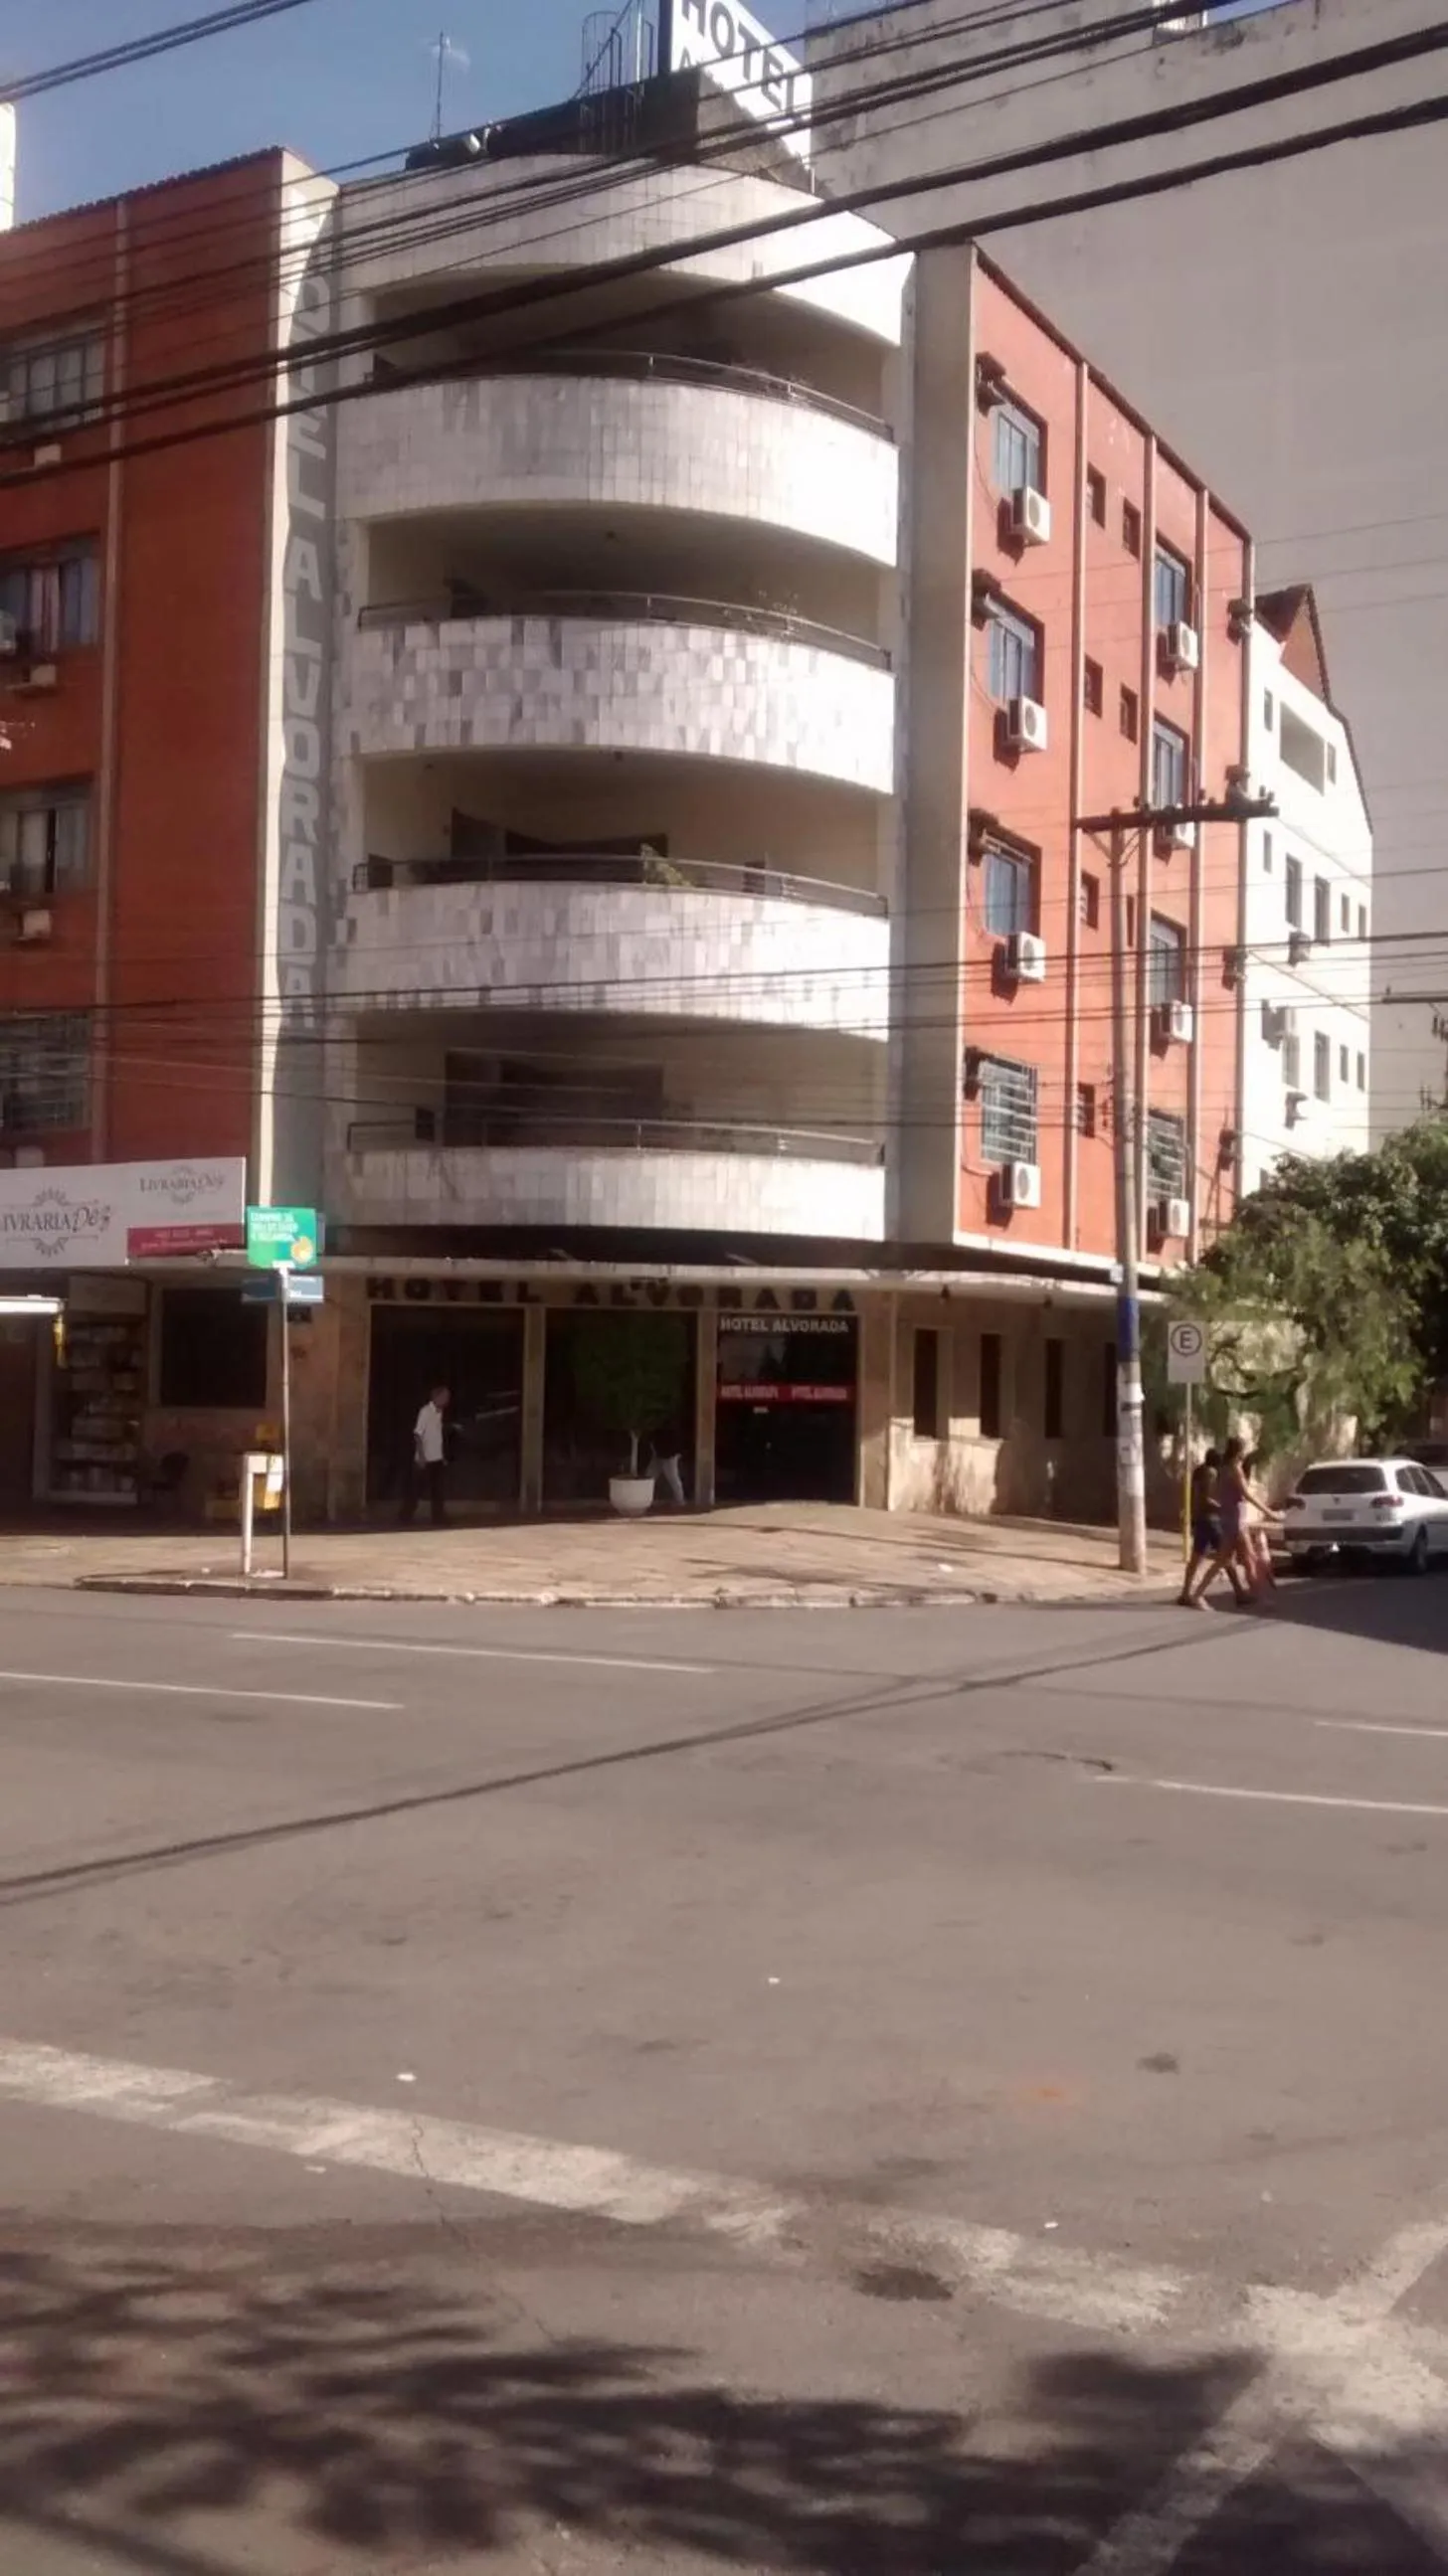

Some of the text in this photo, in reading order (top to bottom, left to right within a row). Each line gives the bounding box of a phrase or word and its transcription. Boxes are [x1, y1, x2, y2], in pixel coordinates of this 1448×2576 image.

[279, 534, 323, 1029] ALVORADA
[0, 1211, 72, 1232] IVRARIA
[365, 1277, 856, 1310] HOTEL ALVORADA
[720, 1317, 849, 1333] HOTEL ALVORADA
[1179, 1330, 1192, 1349] E
